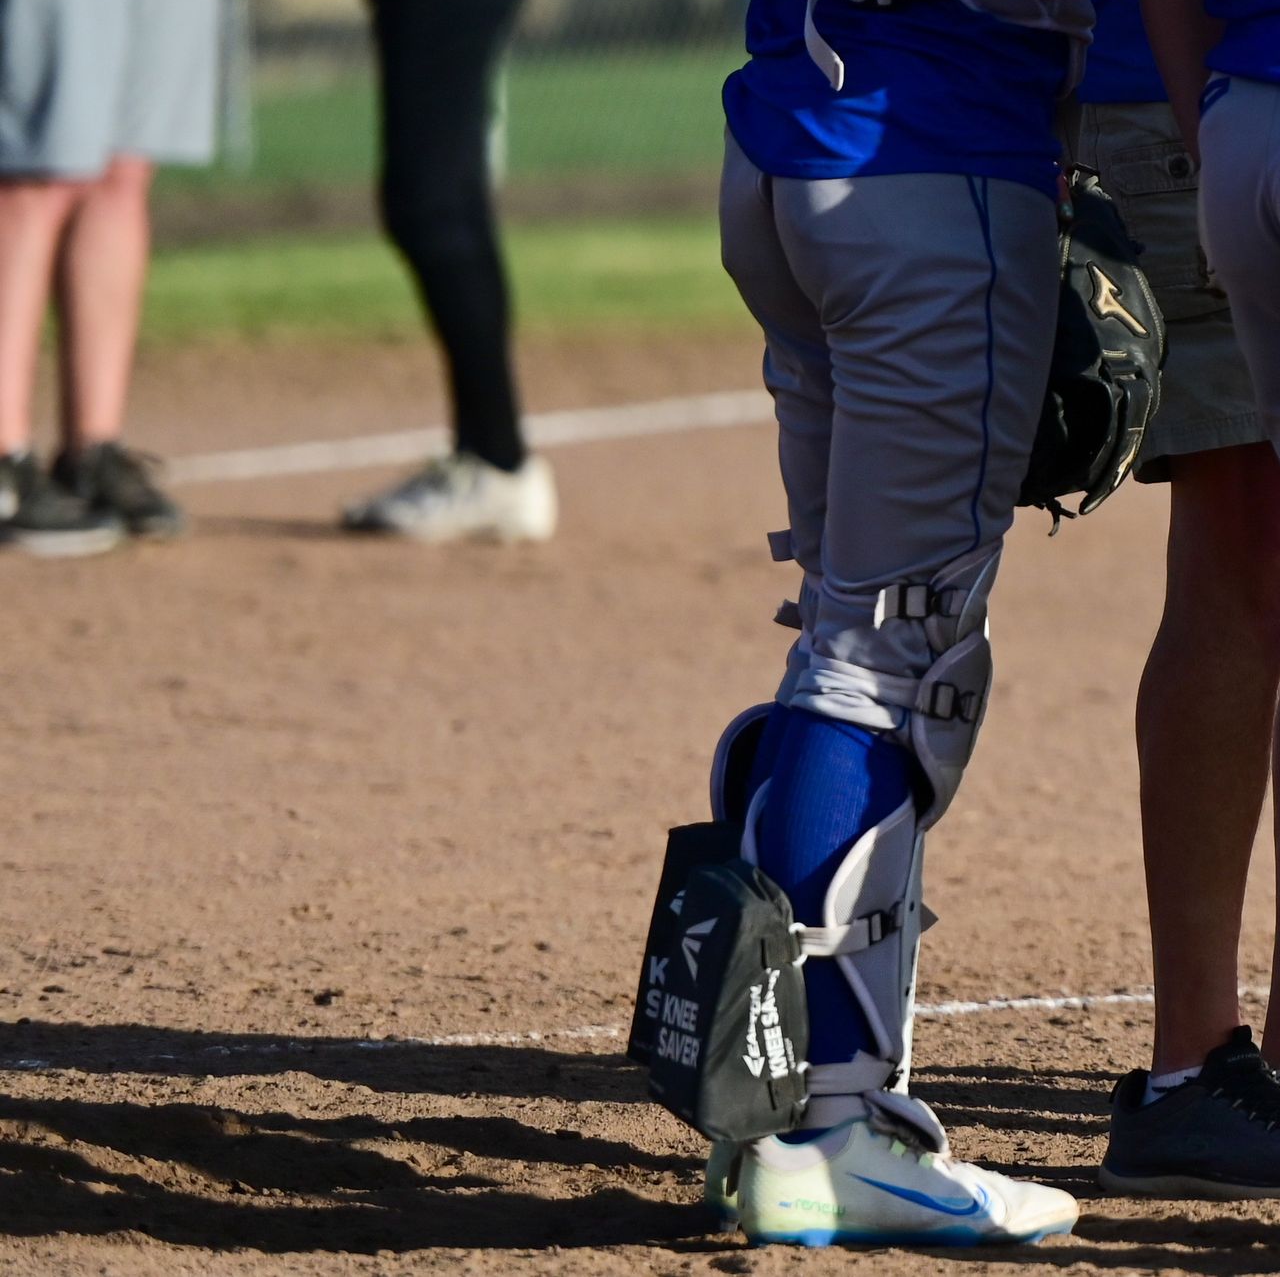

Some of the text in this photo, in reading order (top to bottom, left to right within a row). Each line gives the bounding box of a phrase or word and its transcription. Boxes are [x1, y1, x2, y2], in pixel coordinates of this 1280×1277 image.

[662, 993, 700, 1033] KNEE
[657, 1026, 701, 1070] SAVER
[763, 1025, 789, 1080] KNEE
